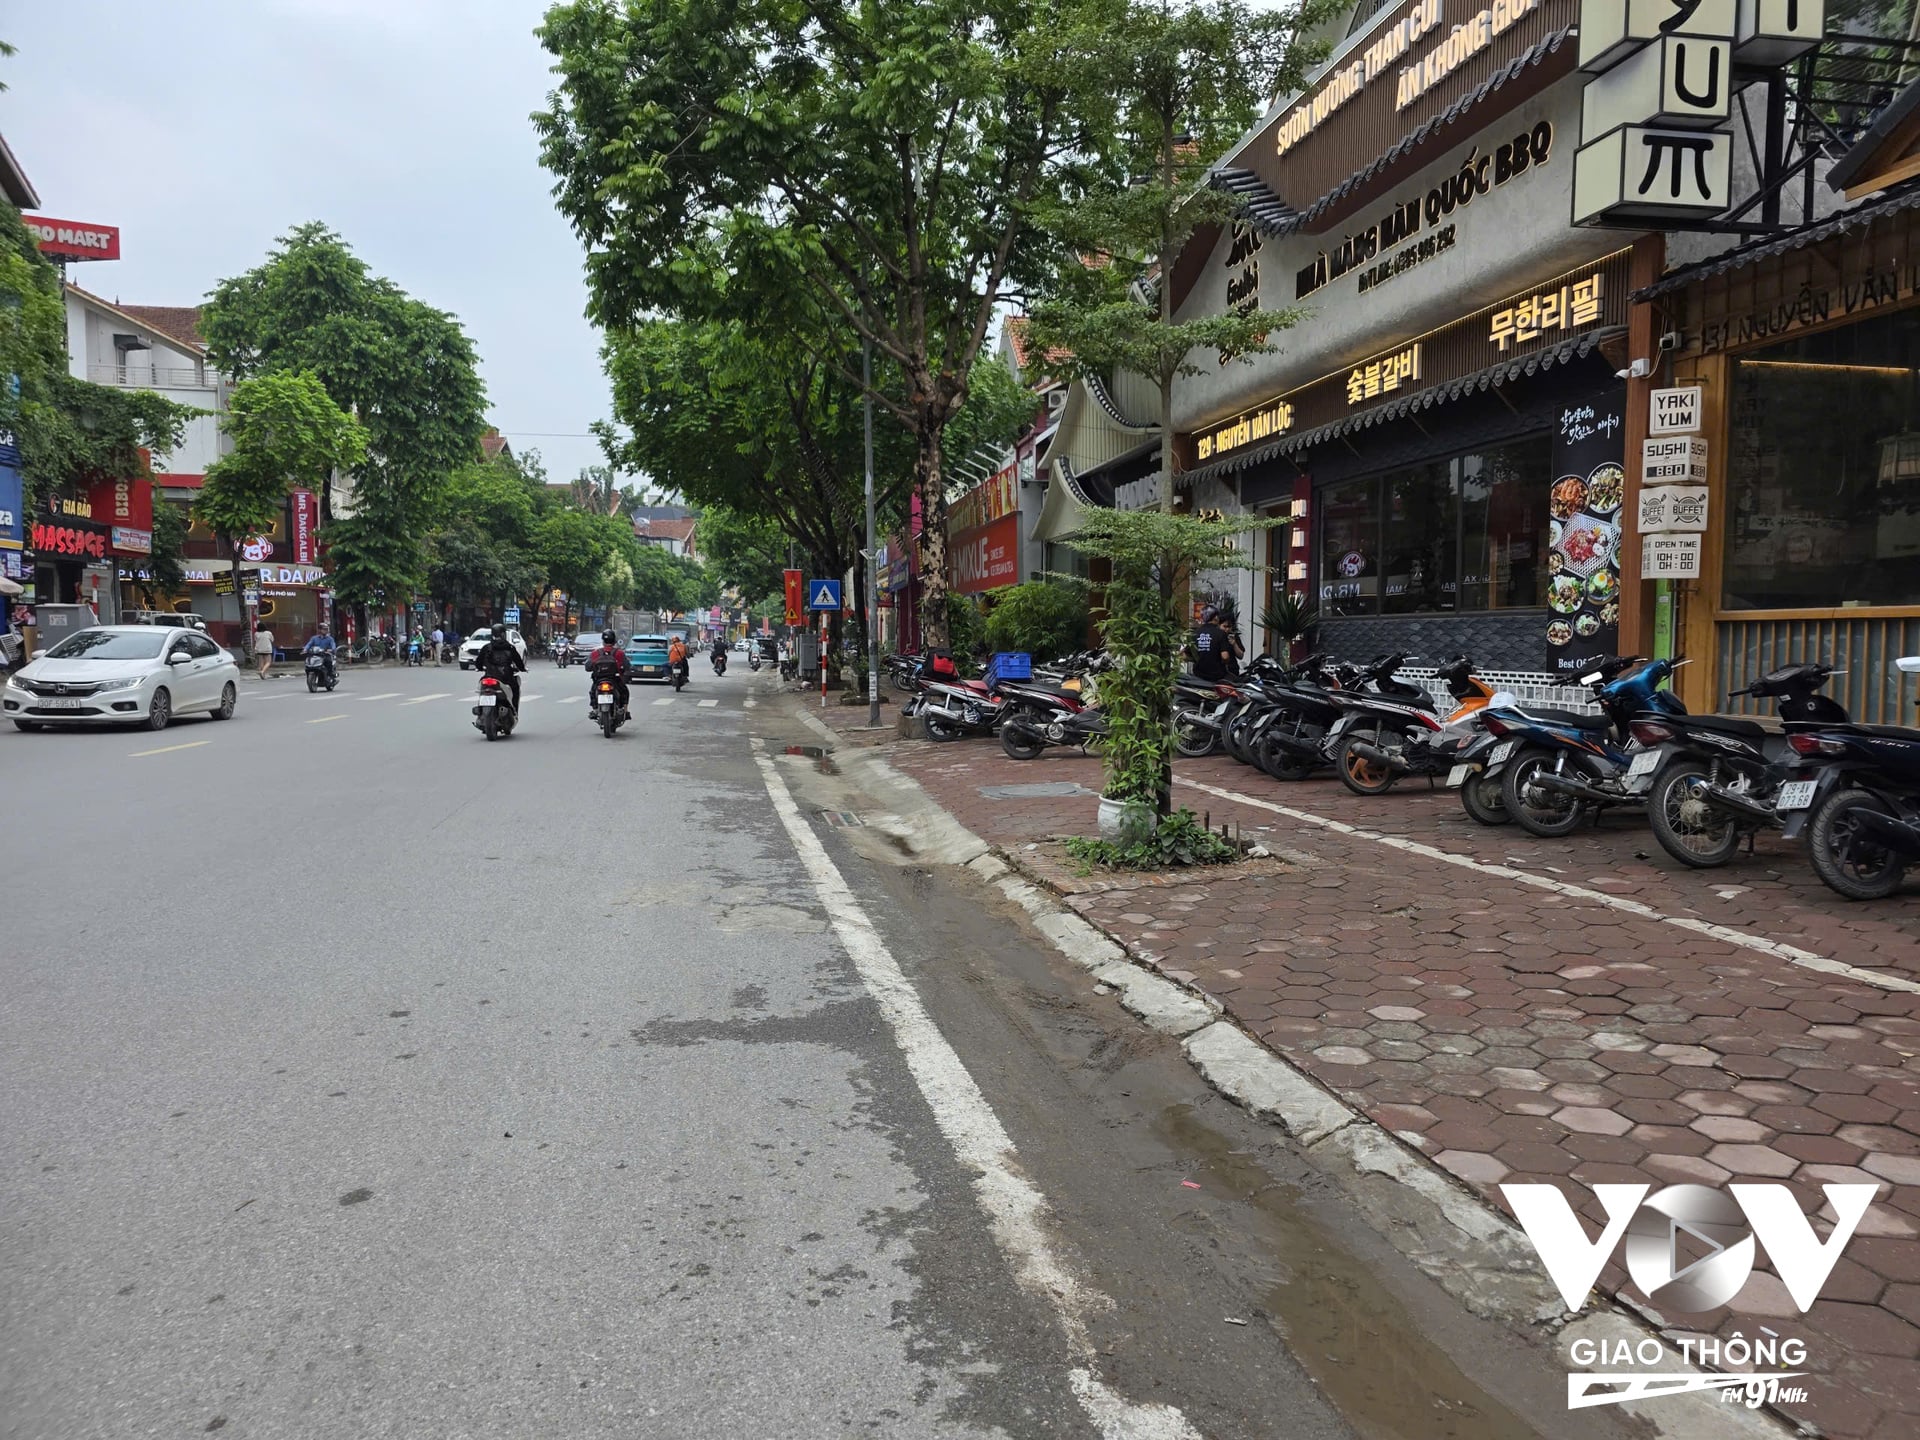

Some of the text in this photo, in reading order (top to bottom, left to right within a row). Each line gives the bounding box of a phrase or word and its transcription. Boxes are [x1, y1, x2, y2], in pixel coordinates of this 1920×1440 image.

[1396, 62, 1425, 112] ĂN
[1424, 10, 1491, 91] KHÔNG
[1277, 103, 1312, 156] SƯỜN
[1312, 61, 1364, 127] NƯỚNG
[1363, 18, 1410, 82] THAN
[1425, 146, 1492, 227] QUỐC
[1495, 121, 1553, 188] BBQ
[57, 228, 110, 249] MART
[1844, 267, 1899, 314] VĂN
[1489, 273, 1604, 351] 무한리필
[1347, 343, 1421, 404] 숯불갈비
[1657, 394, 1694, 409] YAKI
[1658, 411, 1692, 427] YUM
[1198, 435, 1212, 460] 129
[1216, 416, 1250, 453] NGUYỄN
[1252, 411, 1271, 441] VĂN
[1272, 401, 1295, 436] LỘC
[1647, 442, 1686, 457] SUSHI
[63, 497, 92, 518] GIA BẢO
[1642, 506, 1665, 517] BUFFET
[1672, 505, 1704, 515] BUFFET
[31, 521, 105, 558] MASSAGE
[958, 537, 988, 583] MIXUE
[1558, 658, 1574, 669] Best
